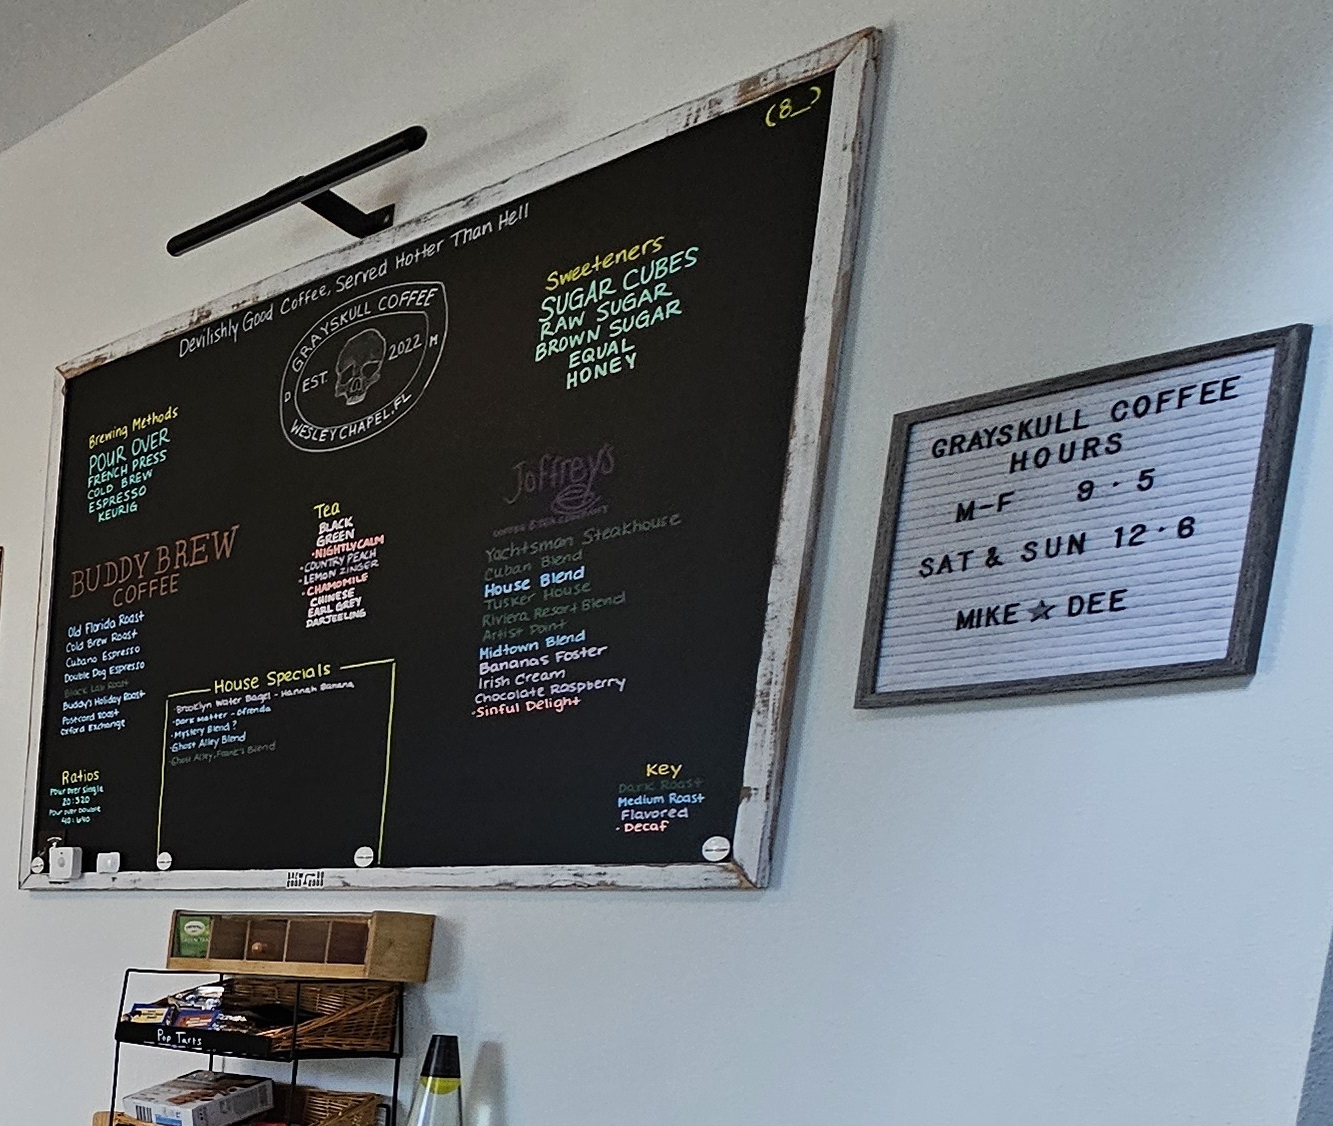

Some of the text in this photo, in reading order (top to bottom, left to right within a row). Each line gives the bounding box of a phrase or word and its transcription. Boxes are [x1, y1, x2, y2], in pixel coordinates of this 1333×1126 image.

[545, 236, 665, 291] Sweeteners
[179, 202, 530, 358] Devilishly Good Coffee, Served Hotter Than Hell
[538, 246, 700, 324] SUGAR CUBES
[540, 282, 672, 341] RAW SUGAR
[291, 287, 438, 374] GRAYSKULL COFFEE
[534, 299, 683, 363] BROWN SUGAR
[387, 333, 423, 361] 2022
[568, 338, 635, 369] EQUAL
[301, 370, 329, 393] EST.
[566, 352, 638, 390] HONEY
[89, 406, 179, 449] Brewing Methods
[290, 418, 337, 442] WESLEY
[932, 375, 1241, 459] GRAYSKULL COFFEE
[89, 427, 170, 475] POUR OVER
[1009, 433, 1123, 473] HOURS
[88, 449, 167, 488] FRENCH PRESS
[87, 468, 153, 500] COLD BREW
[89, 485, 147, 513] ESPRESSO
[98, 501, 138, 522] KEURIG
[314, 502, 341, 519] Tea
[955, 491, 1016, 522] M-F
[316, 528, 355, 547] GREEN
[318, 516, 353, 535] BLACK
[485, 536, 574, 564] Yachtsman
[582, 512, 683, 546] Steakhouse
[356, 534, 385, 549] CALM
[919, 516, 1196, 578] SAT & SUN 12 6
[69, 524, 240, 599] BUDDY BREW
[304, 548, 377, 573] COUNTRY PEACH
[483, 549, 583, 582] Cuban Blend
[112, 573, 180, 608] COFFEE
[303, 569, 337, 585] LEMON
[306, 572, 369, 597] CHAMOMILE
[484, 565, 585, 598] House Blend
[307, 596, 362, 618] EARL GREY
[309, 587, 356, 608] CHINESE
[955, 588, 1128, 631] MIKE DEE
[67, 610, 145, 638] Old Florida Roast
[65, 628, 138, 653] Cold Brew Roast
[101, 645, 141, 661] Espresso
[479, 629, 586, 660] Midtown Blend
[92, 667, 107, 680] Dog
[479, 644, 608, 676] Bananas Foster
[214, 663, 331, 694] House Specials
[478, 668, 566, 690] Irish Cream
[123, 689, 146, 701] Roast
[474, 685, 545, 704] Chocolate
[475, 696, 582, 719] Sinful Delight
[221, 731, 247, 744] Blend
[62, 770, 100, 785] Ratios
[618, 793, 705, 807] Medium Roast
[621, 807, 688, 820] Flavored
[624, 820, 669, 832] Decaf
[157, 1028, 202, 1045] Pop Tarts
